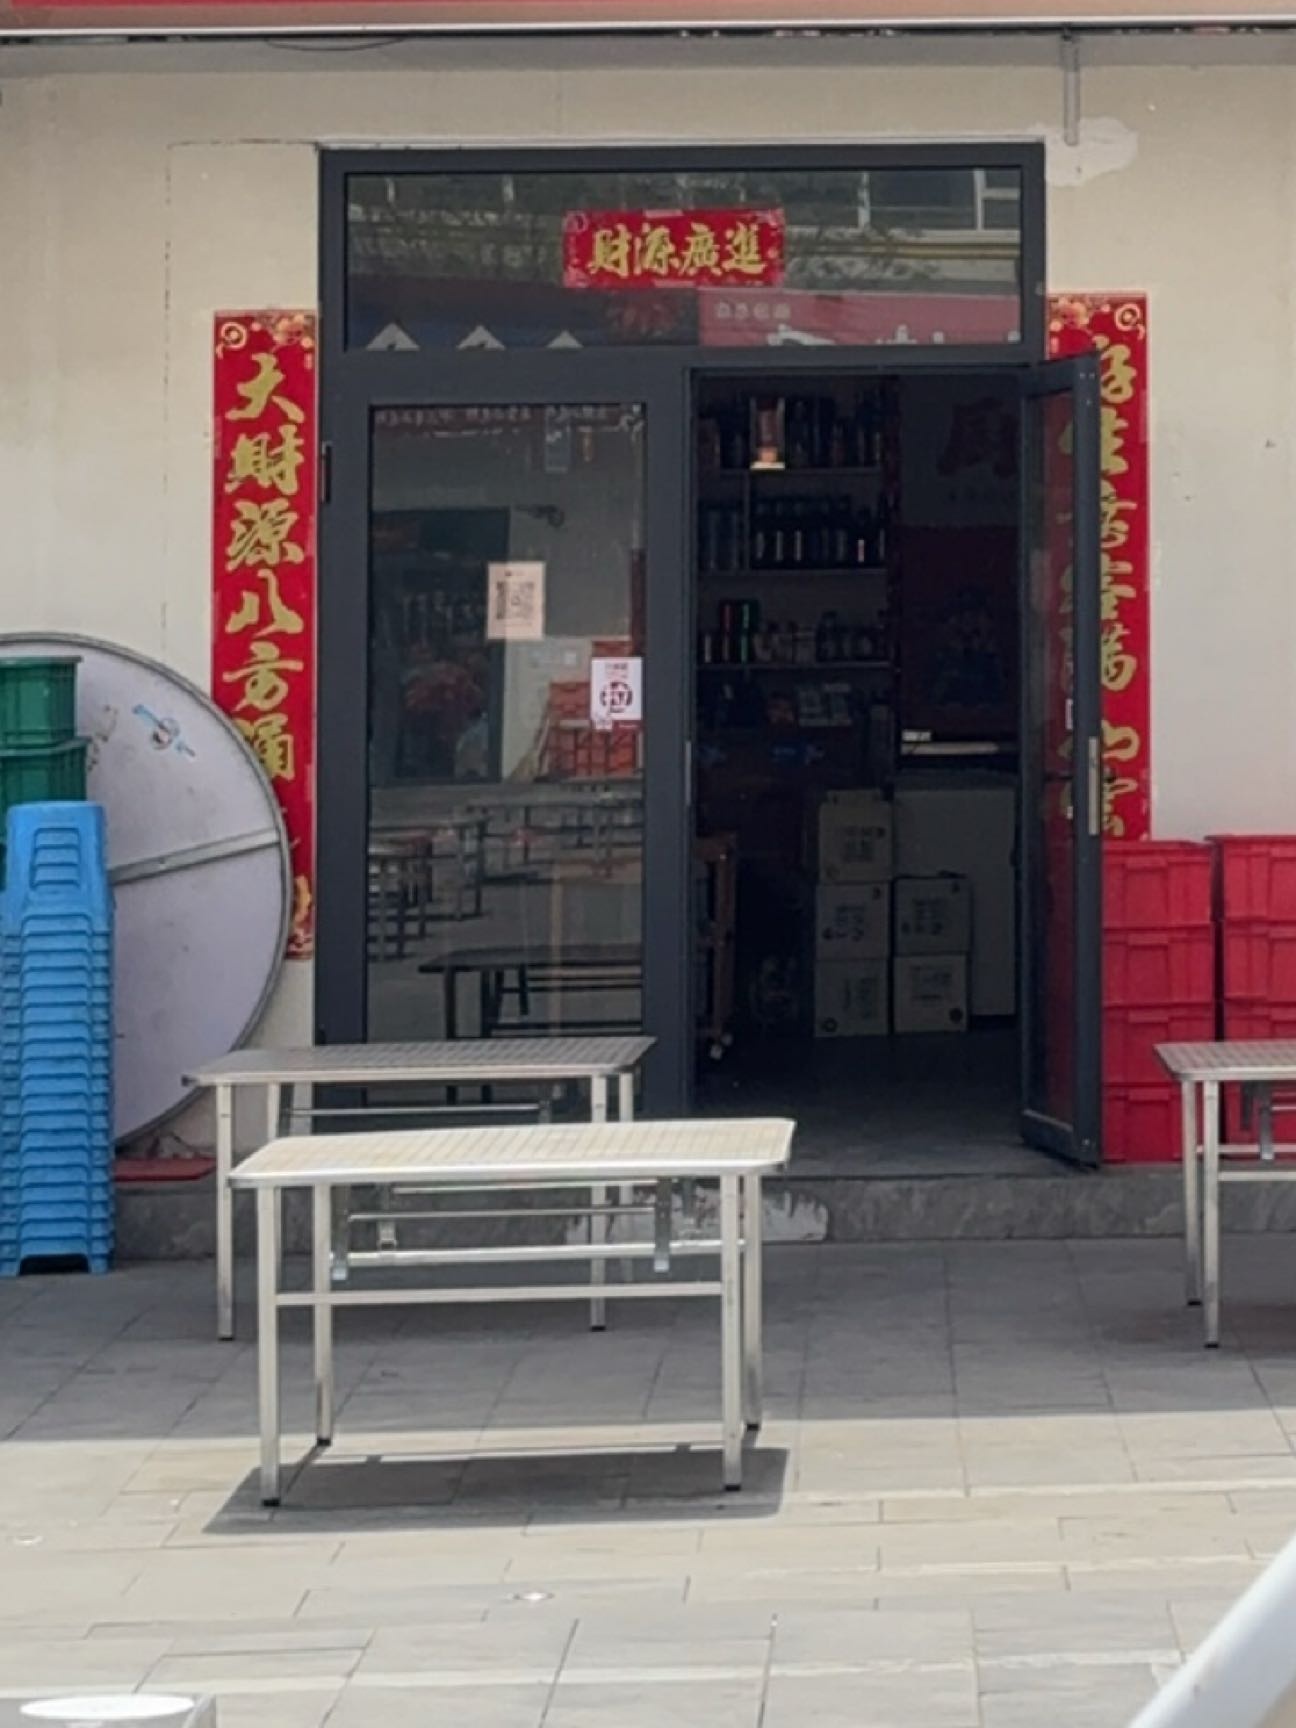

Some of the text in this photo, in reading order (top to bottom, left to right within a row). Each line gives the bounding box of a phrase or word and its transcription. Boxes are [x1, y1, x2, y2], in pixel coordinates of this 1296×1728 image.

[221, 351, 309, 852] 大財源八方涌
